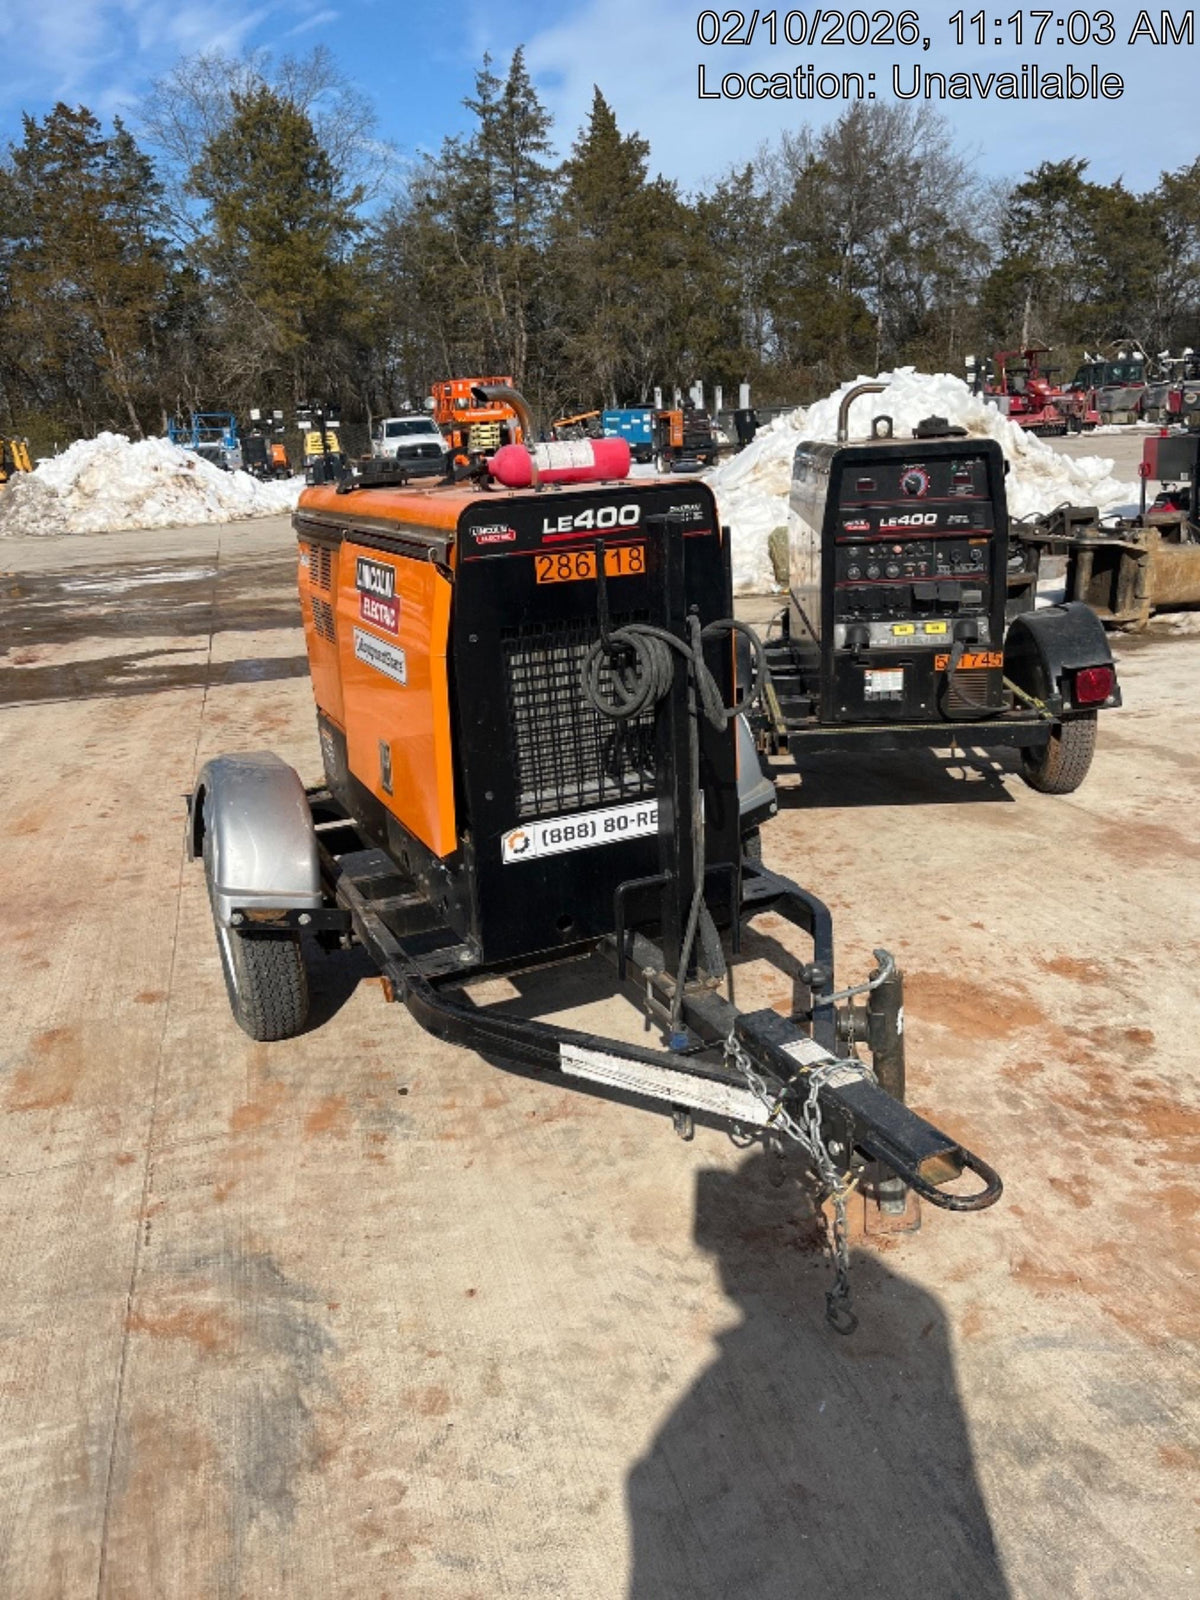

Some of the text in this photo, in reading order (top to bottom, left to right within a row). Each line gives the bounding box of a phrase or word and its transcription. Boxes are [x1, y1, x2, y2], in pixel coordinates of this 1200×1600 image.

[542, 504, 640, 534] LE400
[879, 513, 938, 527] LE400
[538, 547, 643, 582] 28618
[357, 562, 394, 599] LINCOLN
[541, 820, 597, 846] (888)
